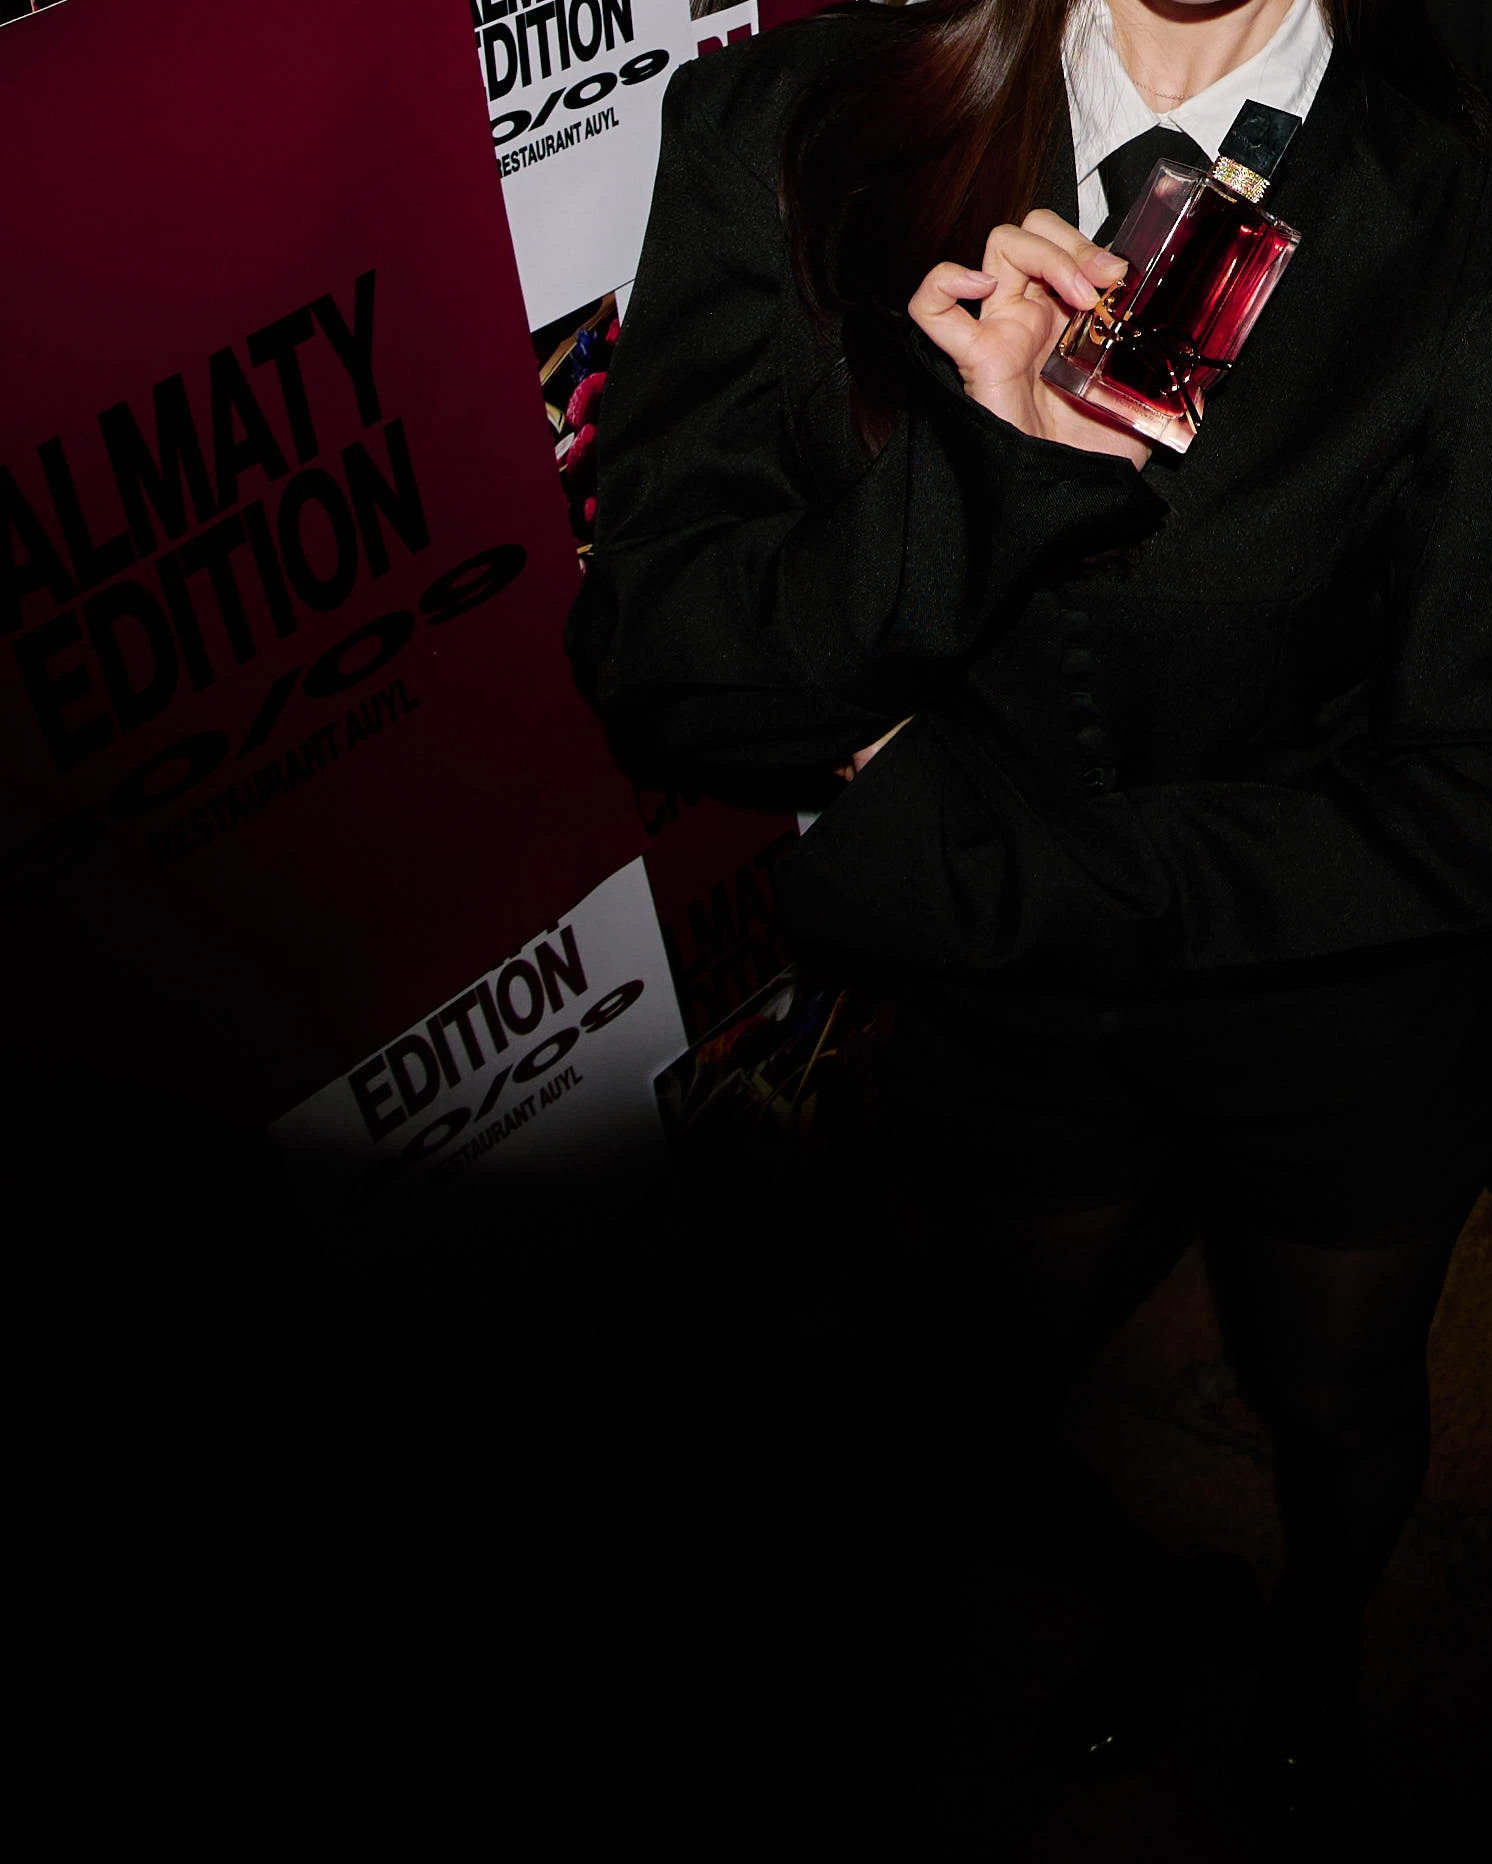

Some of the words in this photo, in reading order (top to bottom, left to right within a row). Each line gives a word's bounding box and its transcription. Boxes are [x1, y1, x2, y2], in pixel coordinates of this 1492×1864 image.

[490, 49, 670, 147] 0/09
[584, 107, 619, 140] AUYL
[0, 269, 381, 636] ALMATY
[14, 417, 430, 774] EDITION
[344, 677, 421, 750] AUYL
[347, 925, 588, 1144] EDITION
[400, 980, 645, 1160] 0/09
[539, 1065, 584, 1109] AUYL
